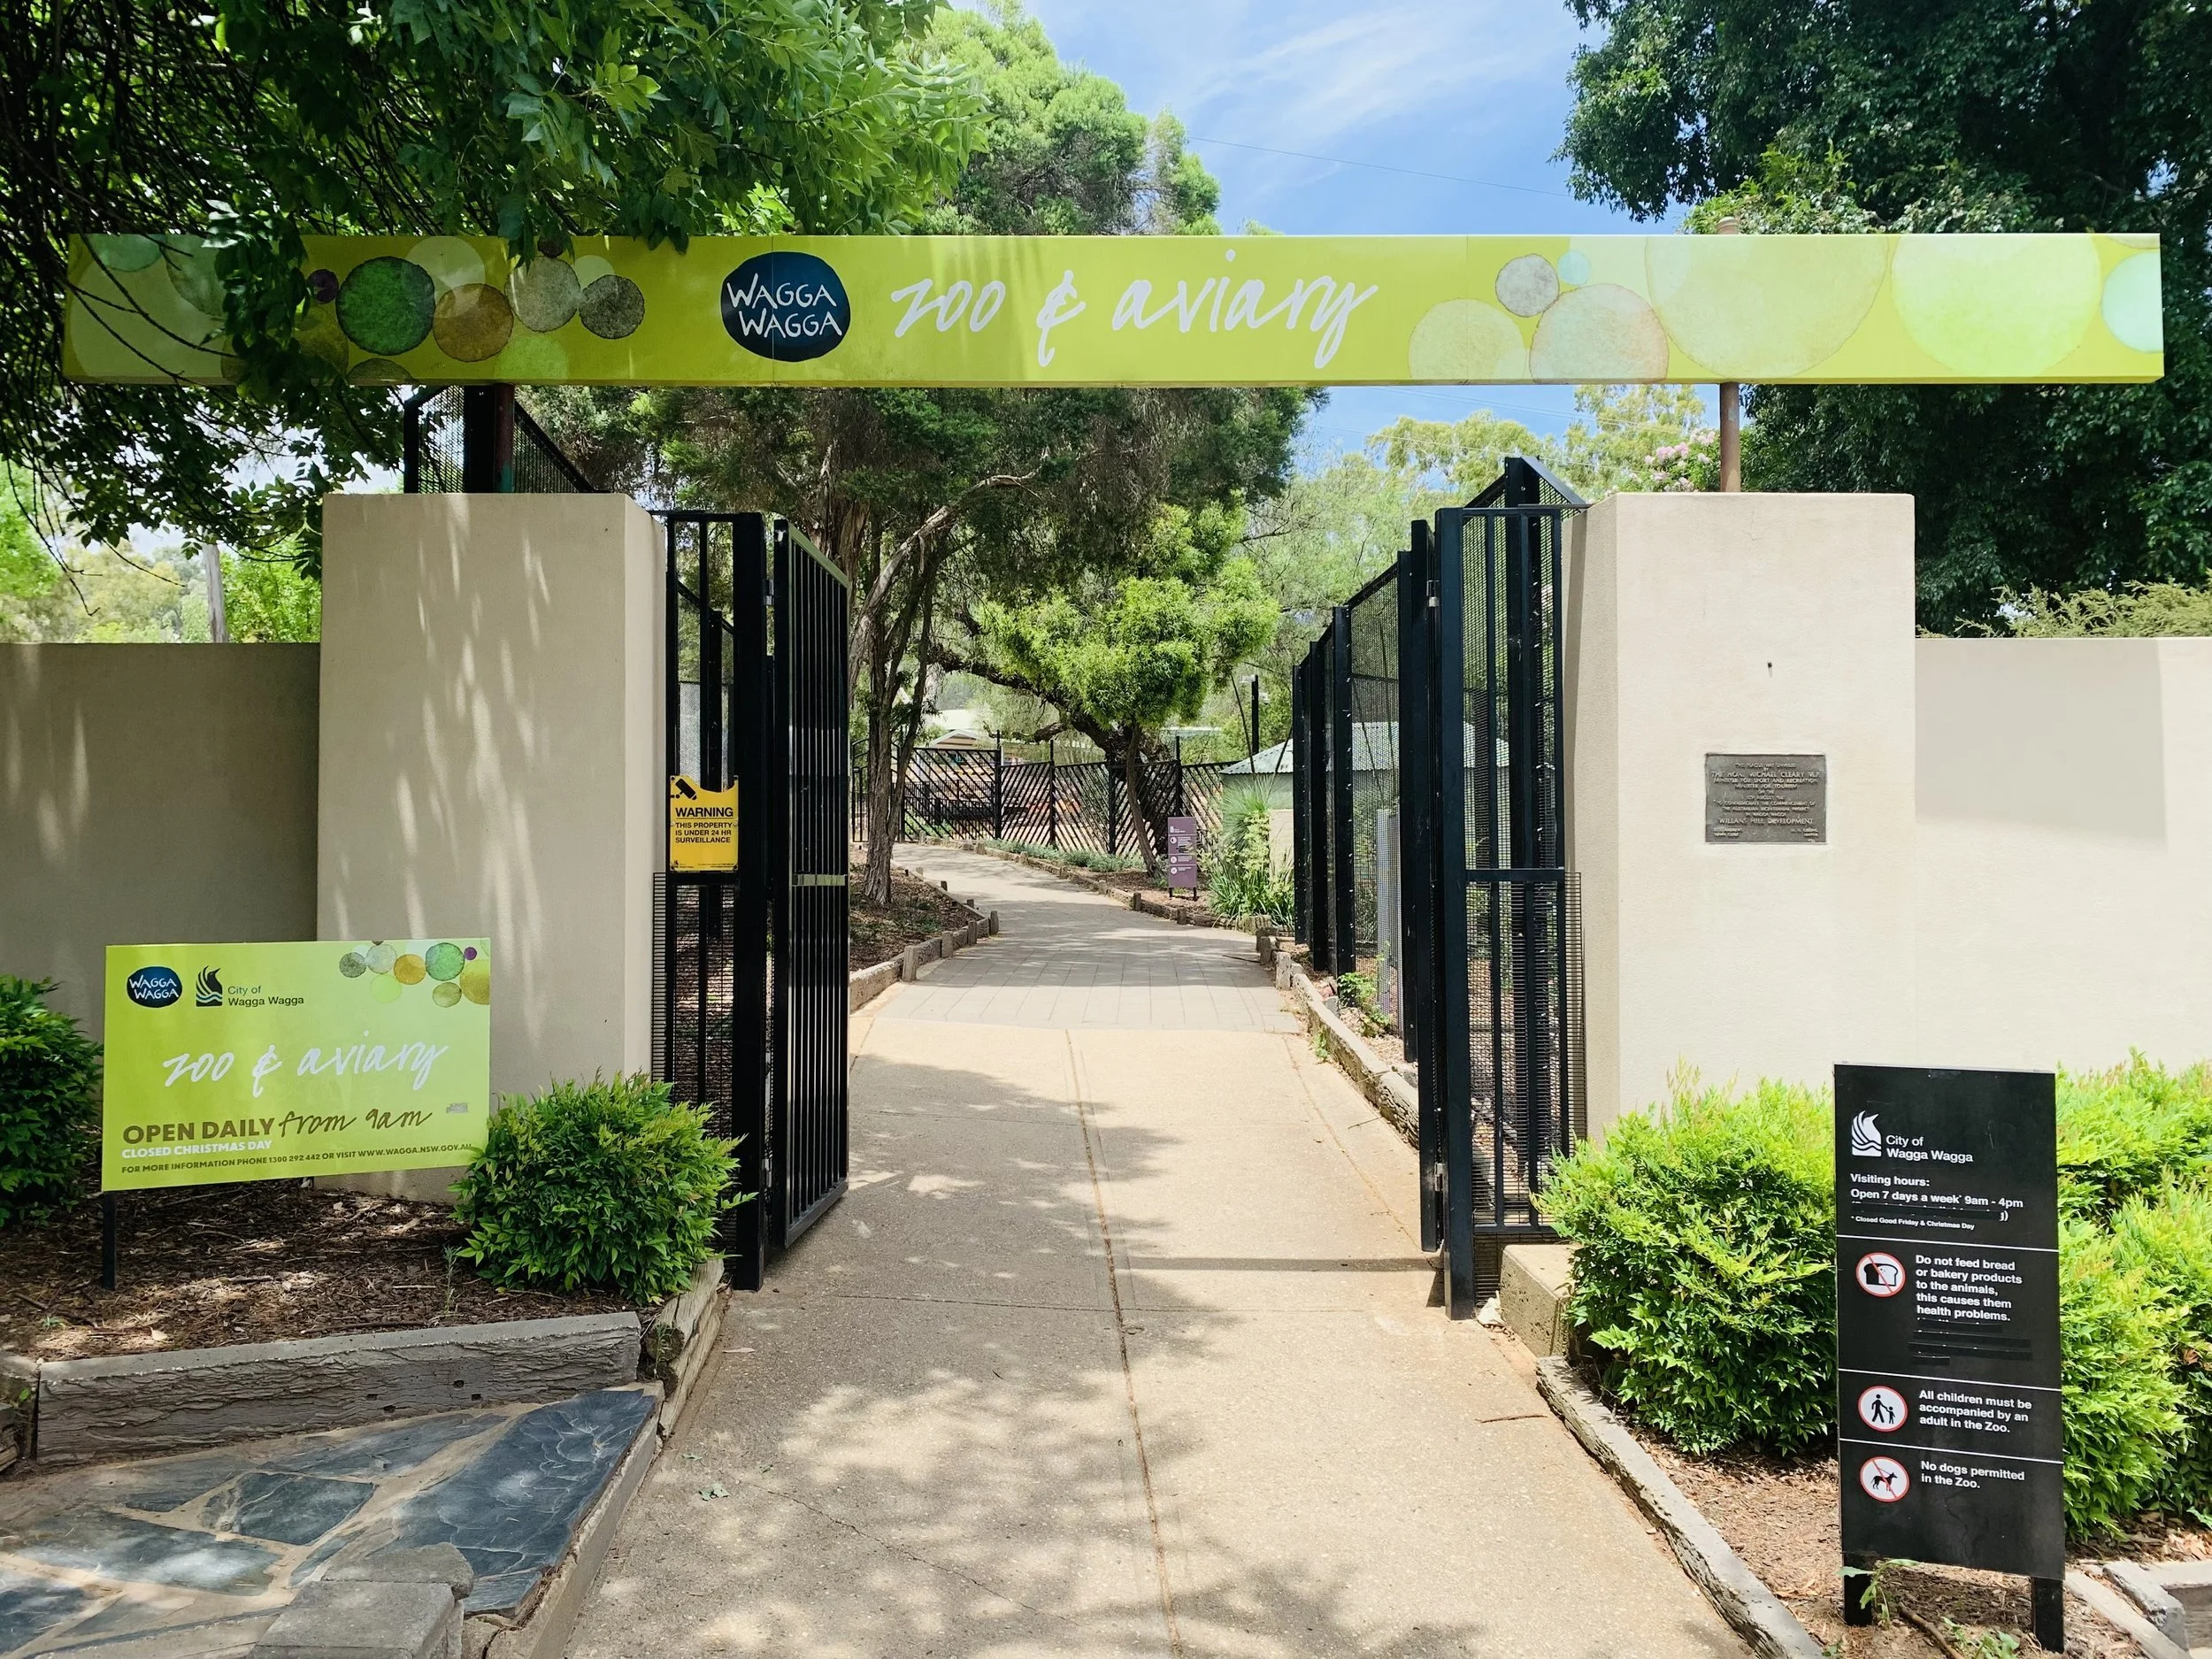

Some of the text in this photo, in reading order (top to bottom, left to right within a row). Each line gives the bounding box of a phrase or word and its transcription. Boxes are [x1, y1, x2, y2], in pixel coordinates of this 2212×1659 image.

[726, 273, 837, 310] WAGGA
[891, 249, 1379, 369] zoo & aviary
[739, 307, 842, 337] WAGGA
[675, 807, 733, 817] WARNING
[129, 974, 177, 988] WAGGA
[134, 988, 179, 1000] WAGGA
[228, 986, 249, 995] City
[228, 996, 304, 1007] Wagga Wagga
[163, 1030, 449, 1098] zoo & aviary
[123, 1108, 433, 1145] OPEN DAILY from 9am
[1886, 1135, 1924, 1147] City of
[122, 1141, 273, 1158] CLOSED CHRISTMAS DAY
[1886, 1148, 1973, 1164] Wagga Wagga
[172, 1159, 235, 1170] INFORMATION
[1850, 1173, 1930, 1187] Visiting hours:
[1851, 1189, 1879, 1199] Open
[1892, 1192, 1918, 1202] days
[1999, 1198, 2024, 1208] 4pm
[1916, 1255, 2015, 1271] Do not feed bread
[1931, 1269, 1969, 1281] bakery
[1971, 1273, 2022, 1284] products
[1931, 1281, 1948, 1290] the
[1951, 1284, 1998, 1296] animals,
[1916, 1293, 2011, 1308] this causes them
[1917, 1305, 2010, 1321] health problems.
[1919, 1390, 2032, 1409] All children must be
[1919, 1403, 1994, 1418] accompanied
[1998, 1410, 2011, 1422] by
[1920, 1417, 2010, 1432] adult in the Zoo.
[1921, 1461, 2024, 1480] No dogs permitted
[1921, 1473, 1980, 1488] in the Zoo.
